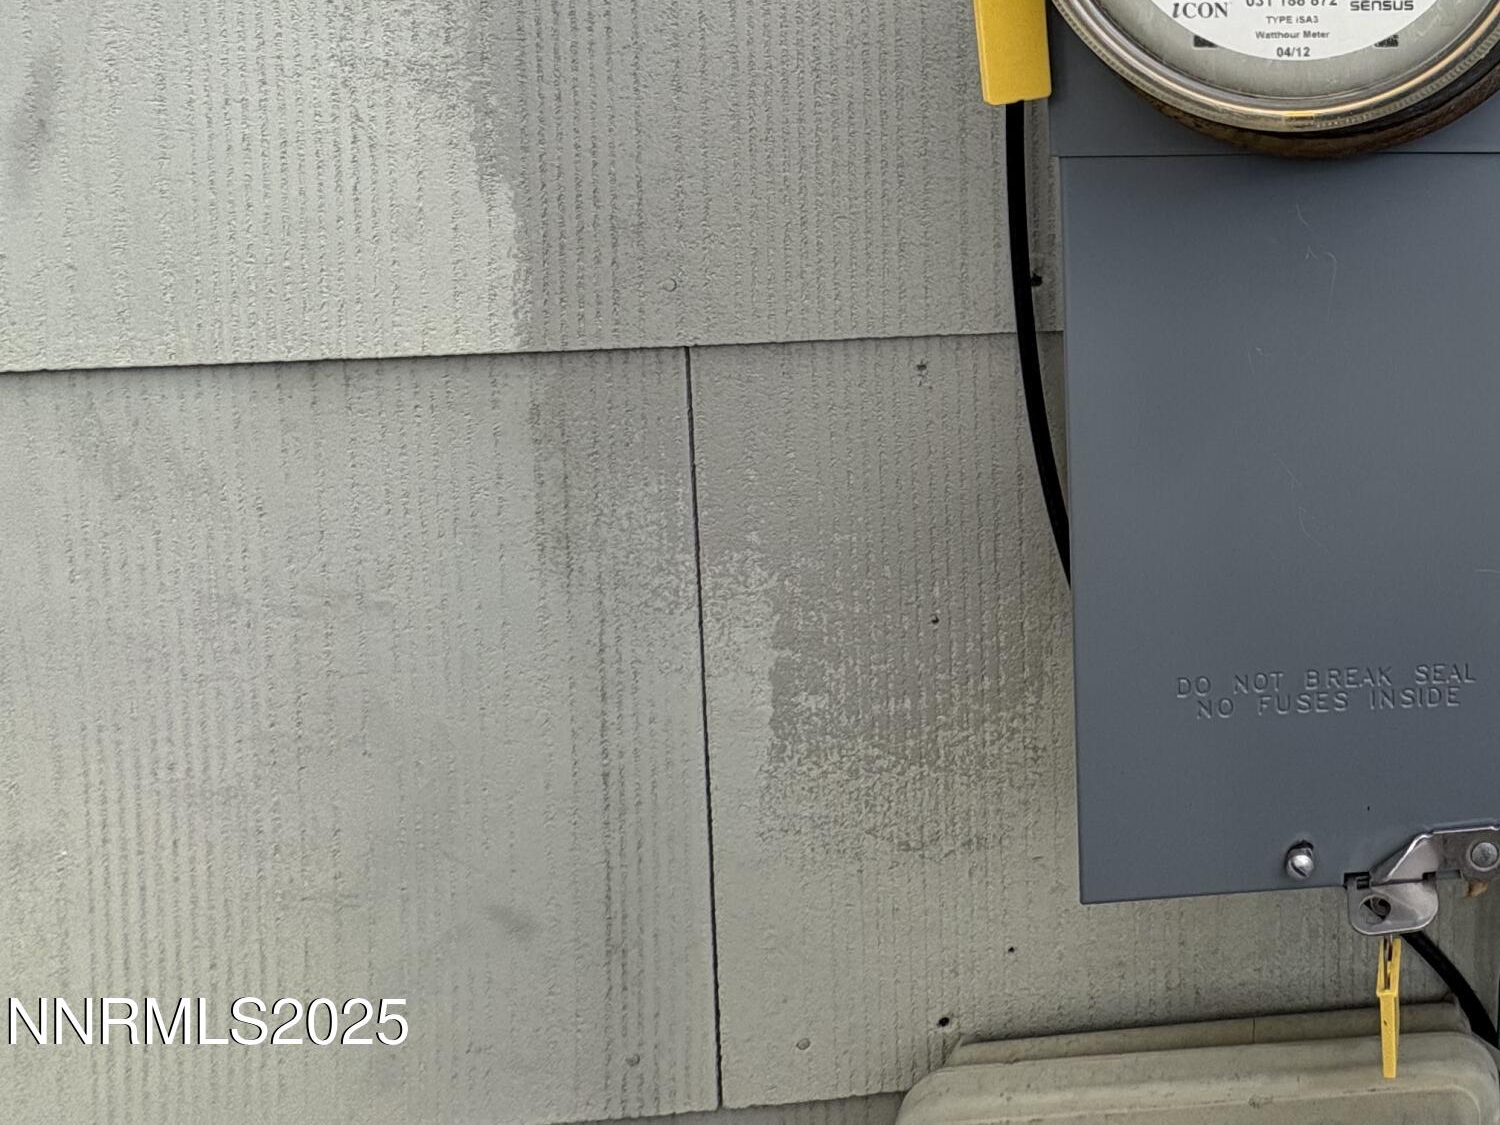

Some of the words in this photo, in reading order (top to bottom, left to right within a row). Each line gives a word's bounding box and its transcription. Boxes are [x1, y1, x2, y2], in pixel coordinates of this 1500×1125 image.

[1266, 16, 1292, 24] TYPE
[1255, 31, 1300, 39] Watthour
[1303, 30, 1330, 38] Meter
[1276, 47, 1311, 57] 04/12
[1176, 676, 1211, 698] DO
[1233, 672, 1284, 695] NOT
[1304, 666, 1393, 690] BREAK
[1415, 663, 1477, 685] SEAL
[1196, 698, 1235, 720] NO
[1258, 691, 1349, 715] FUSES
[1369, 686, 1461, 710] INSIDE
